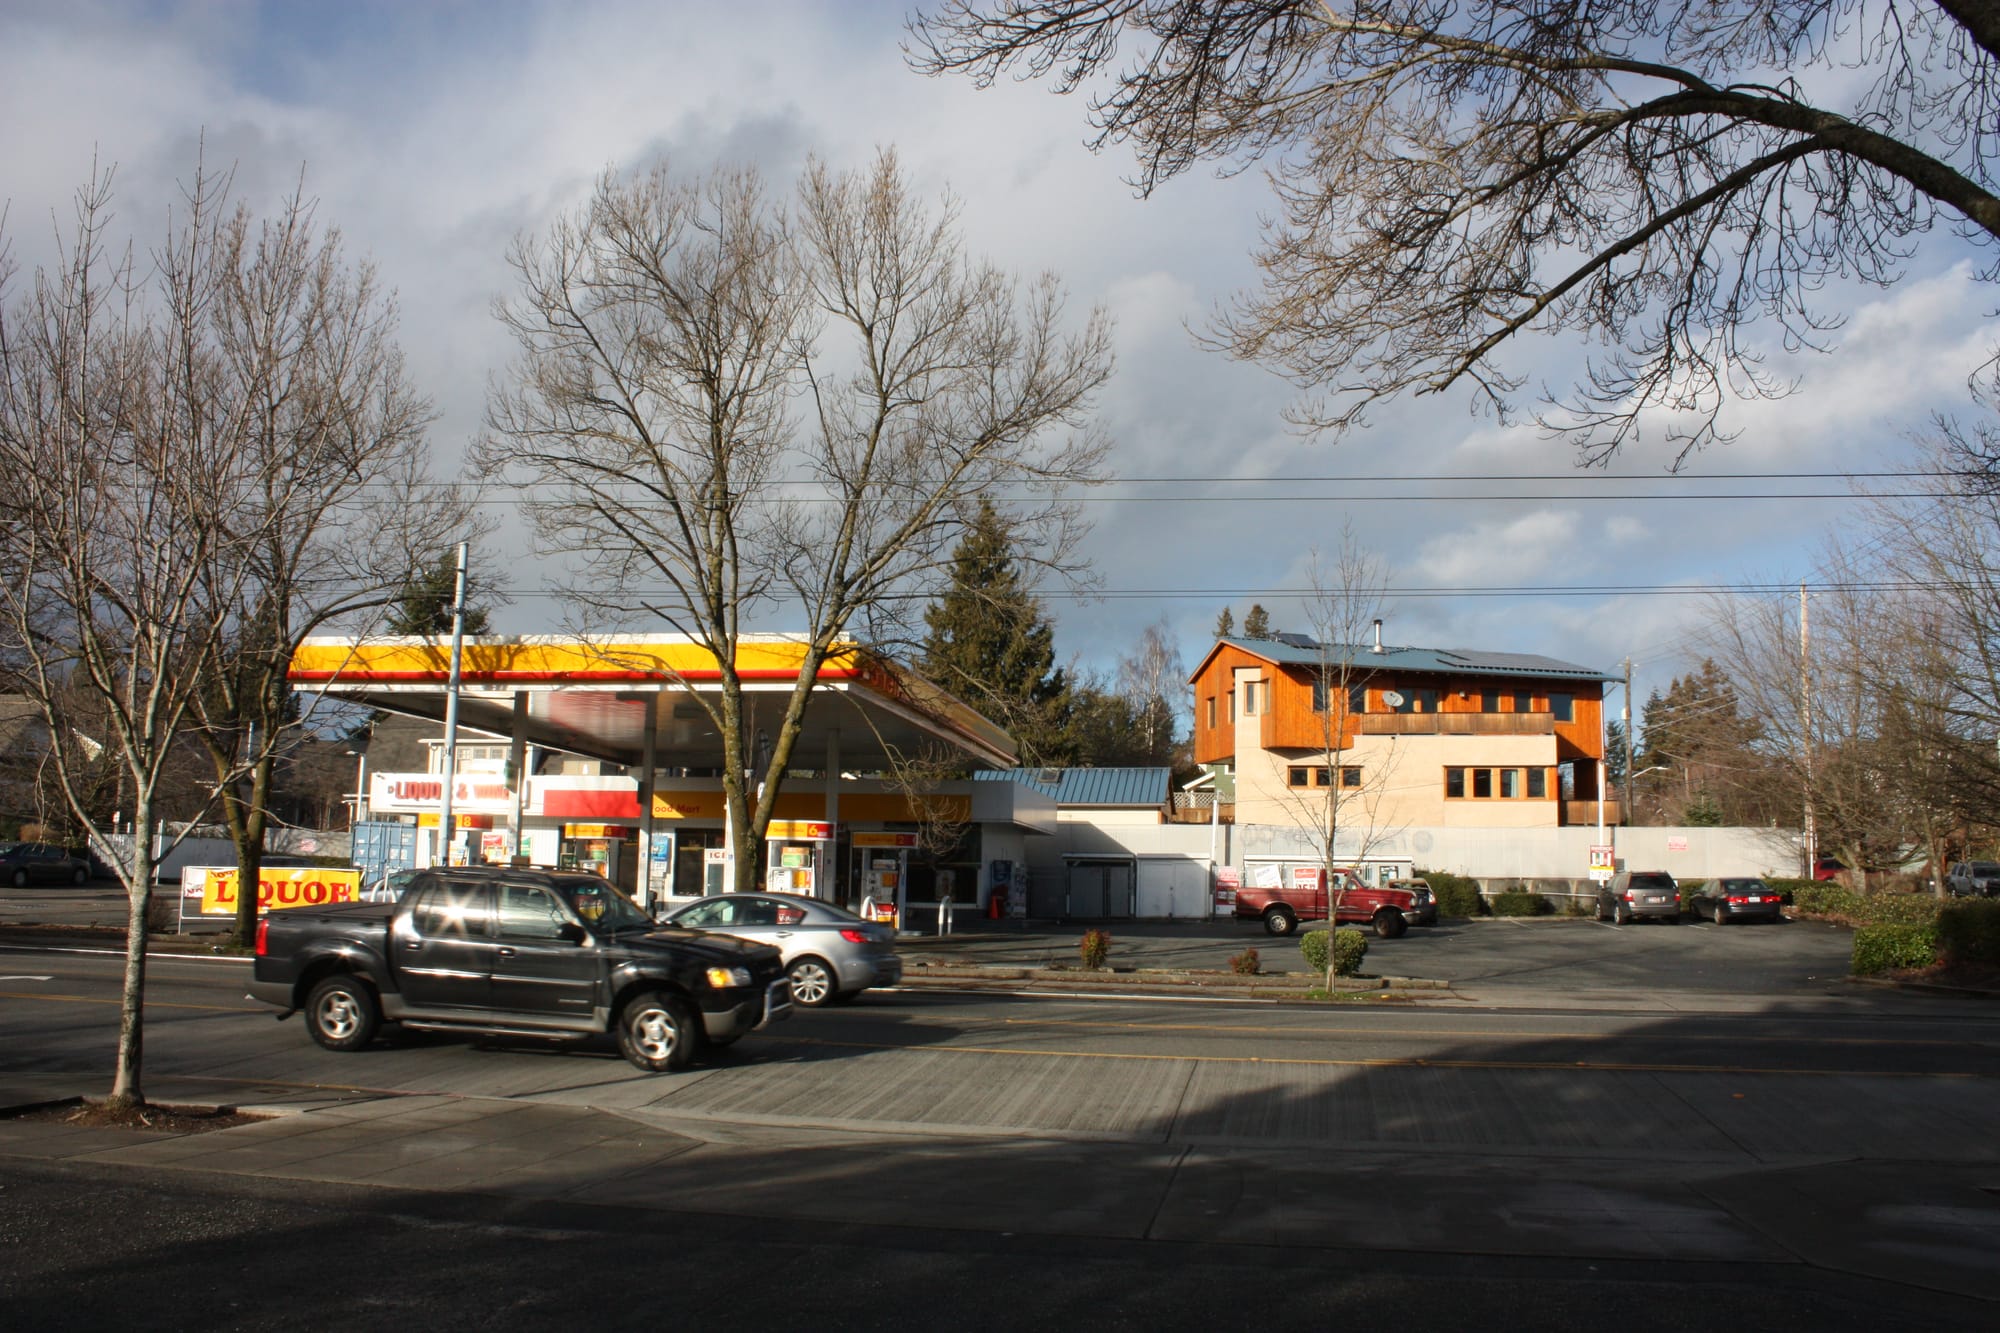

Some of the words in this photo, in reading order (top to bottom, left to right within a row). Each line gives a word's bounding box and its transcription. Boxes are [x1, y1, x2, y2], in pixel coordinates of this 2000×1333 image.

[395, 781, 453, 801] LIQUO
[677, 804, 701, 813] Mart
[463, 815, 472, 827] 8
[808, 824, 818, 836] 6
[215, 881, 352, 907] LQUOR
